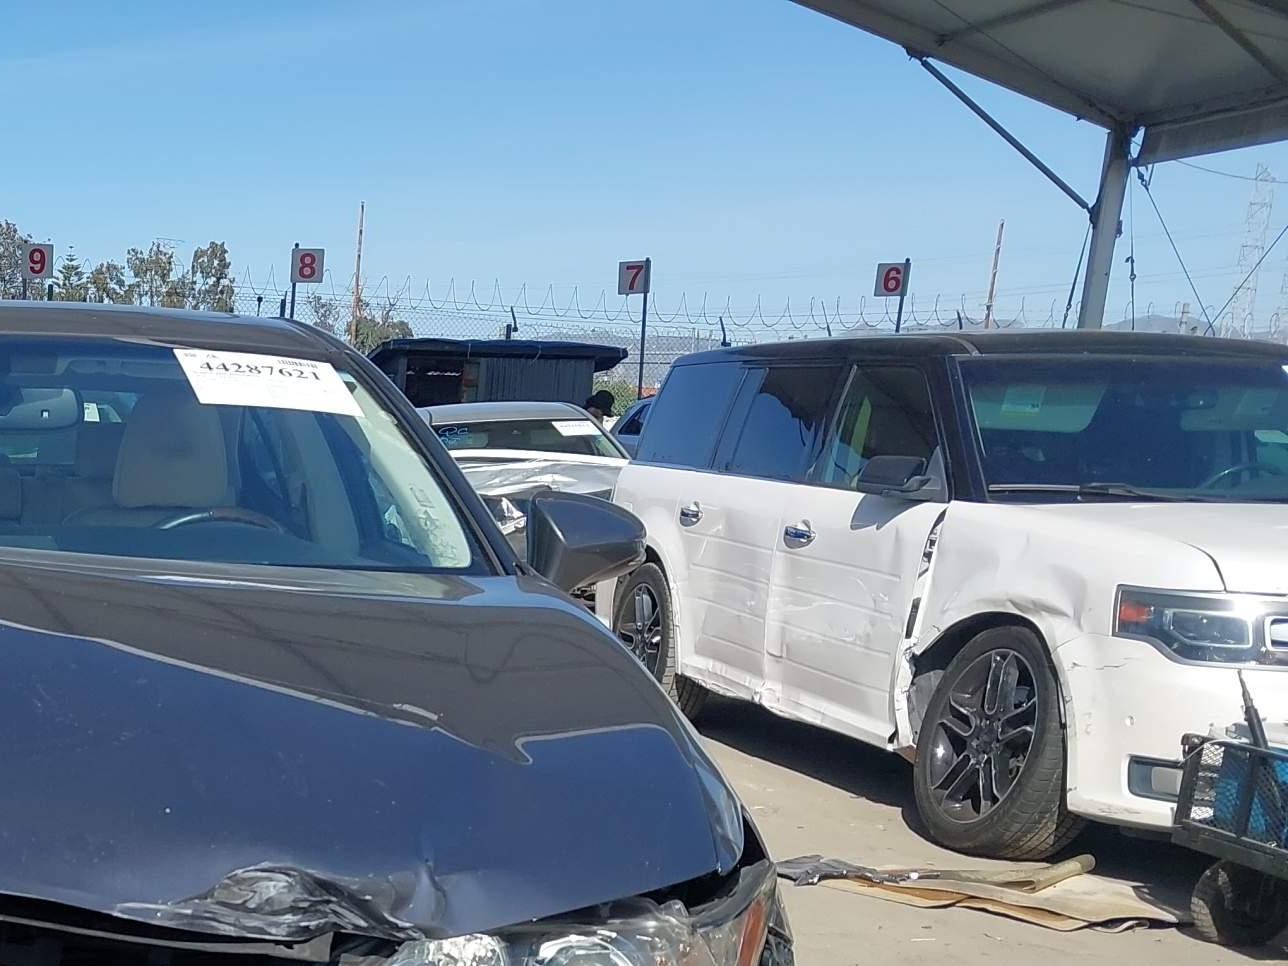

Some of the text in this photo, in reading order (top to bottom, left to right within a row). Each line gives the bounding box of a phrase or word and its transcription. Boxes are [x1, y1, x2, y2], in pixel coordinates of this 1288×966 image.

[28, 247, 46, 275] 9
[298, 252, 317, 279] 8
[625, 264, 644, 291] 7
[883, 266, 902, 293] 6
[199, 360, 321, 381] 44287621
